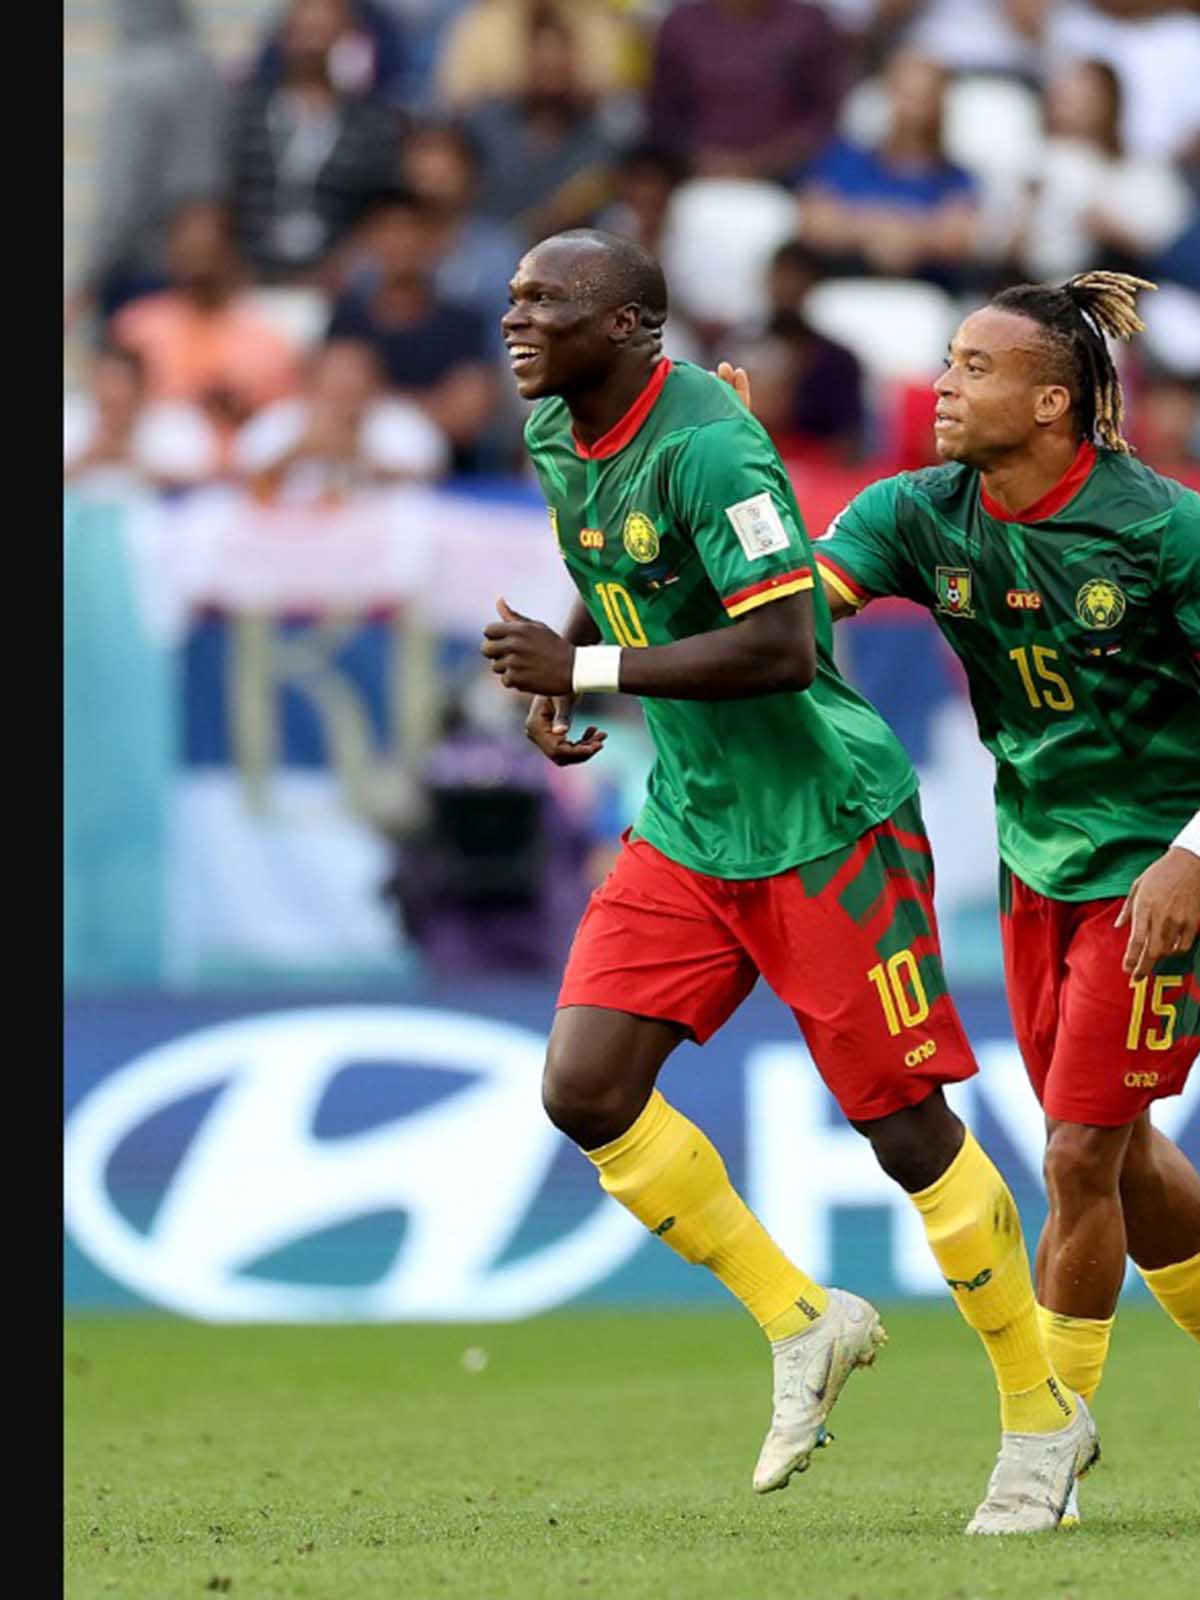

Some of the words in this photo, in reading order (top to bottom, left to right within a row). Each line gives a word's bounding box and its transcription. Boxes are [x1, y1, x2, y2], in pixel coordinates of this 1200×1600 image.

[595, 582, 649, 648] 10
[1006, 589, 1042, 609] one
[1009, 645, 1075, 712] 15
[867, 949, 930, 1037] 10
[1125, 974, 1184, 1051] 15
[904, 1039, 938, 1068] one
[1124, 1071, 1159, 1088] one
[946, 1268, 993, 1292] ne
